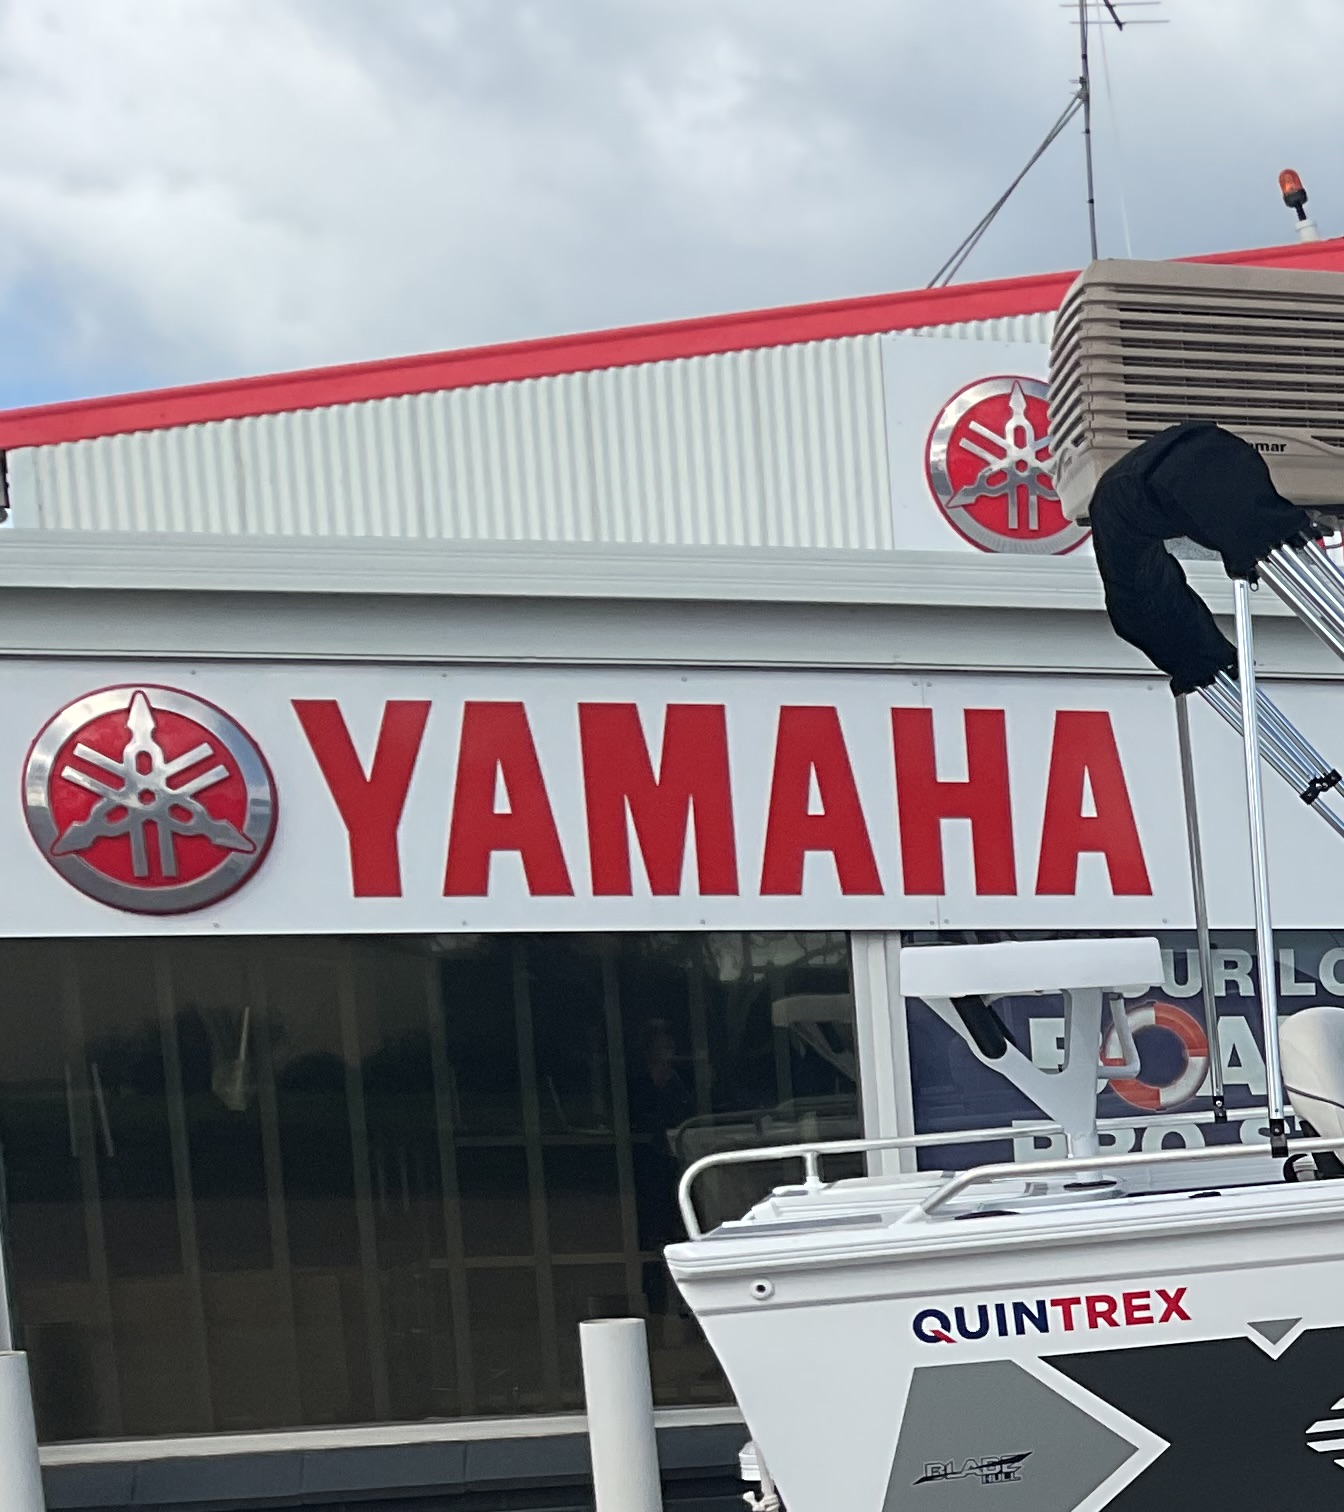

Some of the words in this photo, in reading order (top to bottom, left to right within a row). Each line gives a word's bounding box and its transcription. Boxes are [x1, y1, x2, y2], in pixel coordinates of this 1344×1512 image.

[1252, 442, 1287, 452] mar
[291, 699, 1153, 899] YAMAHA
[1115, 948, 1256, 999] UR
[912, 1287, 1192, 1344] QUINTREX
